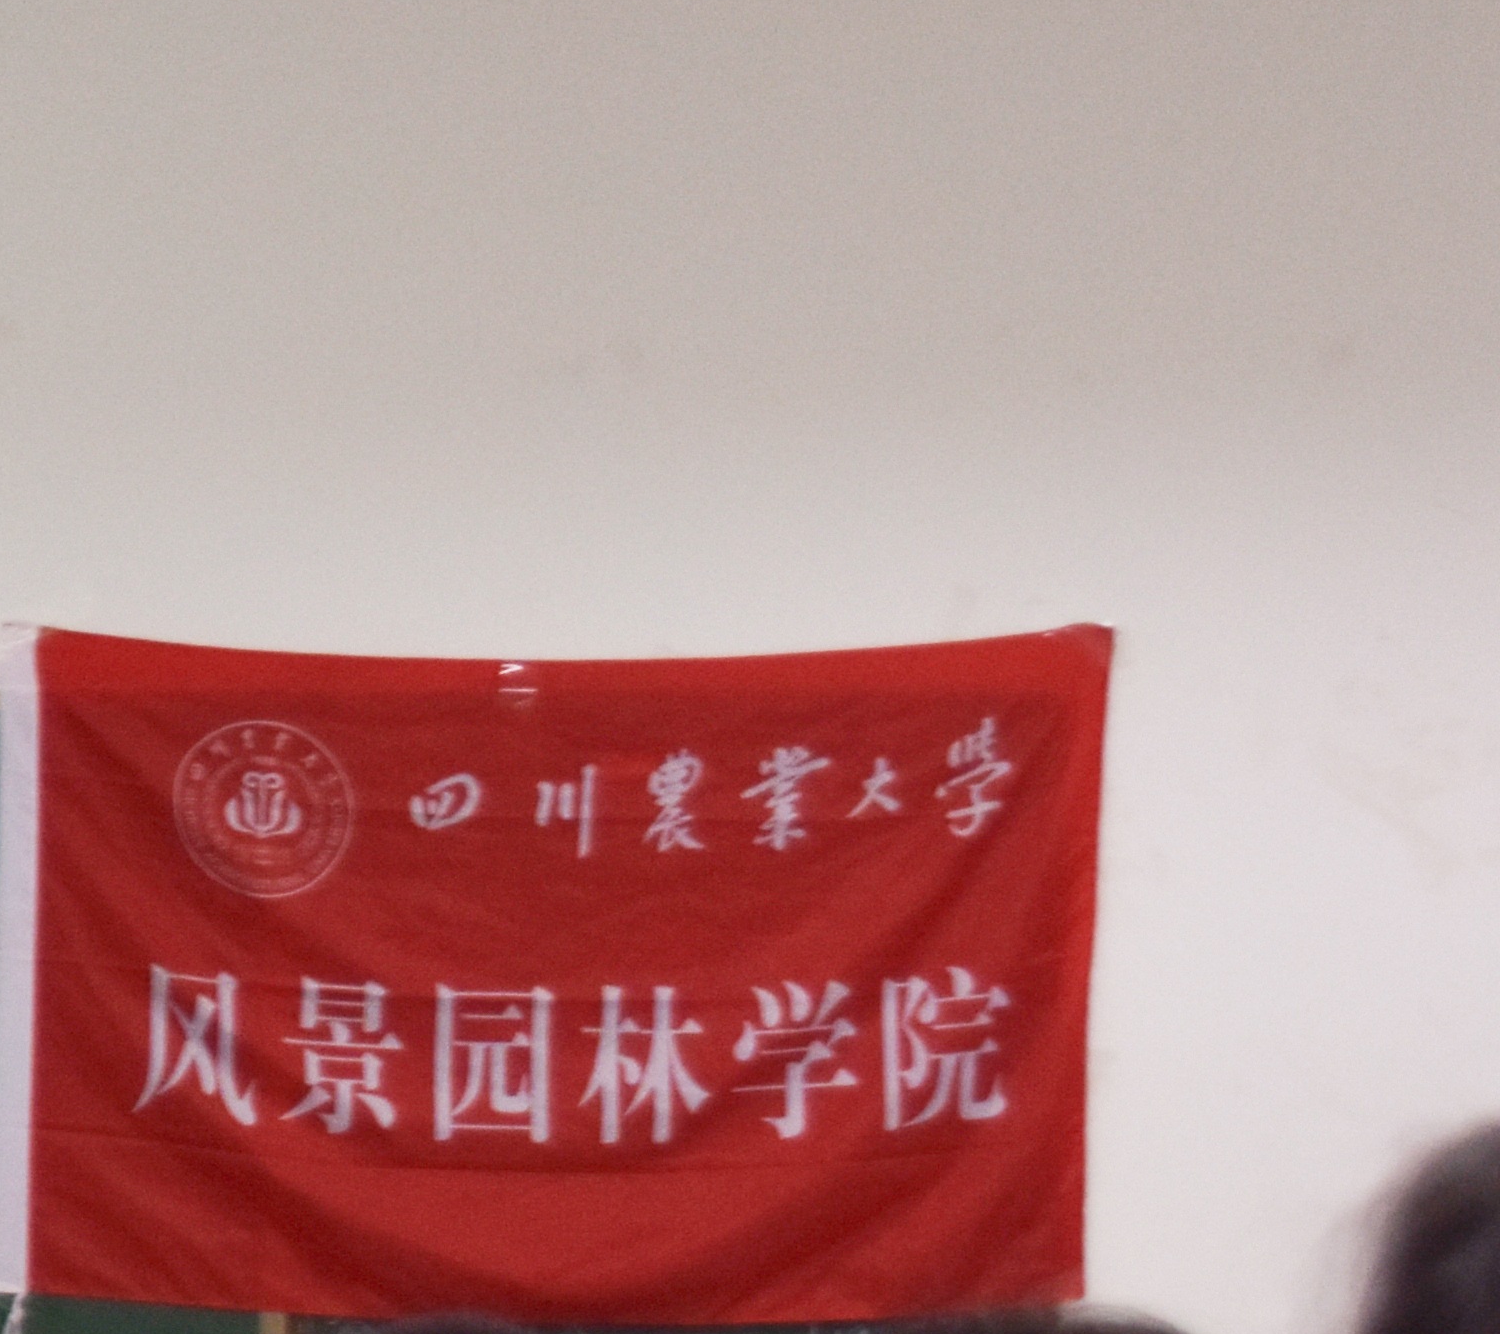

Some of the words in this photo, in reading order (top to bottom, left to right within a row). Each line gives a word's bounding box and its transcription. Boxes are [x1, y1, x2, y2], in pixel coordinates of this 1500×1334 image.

[132, 964, 1012, 1145] 风景园林学院
